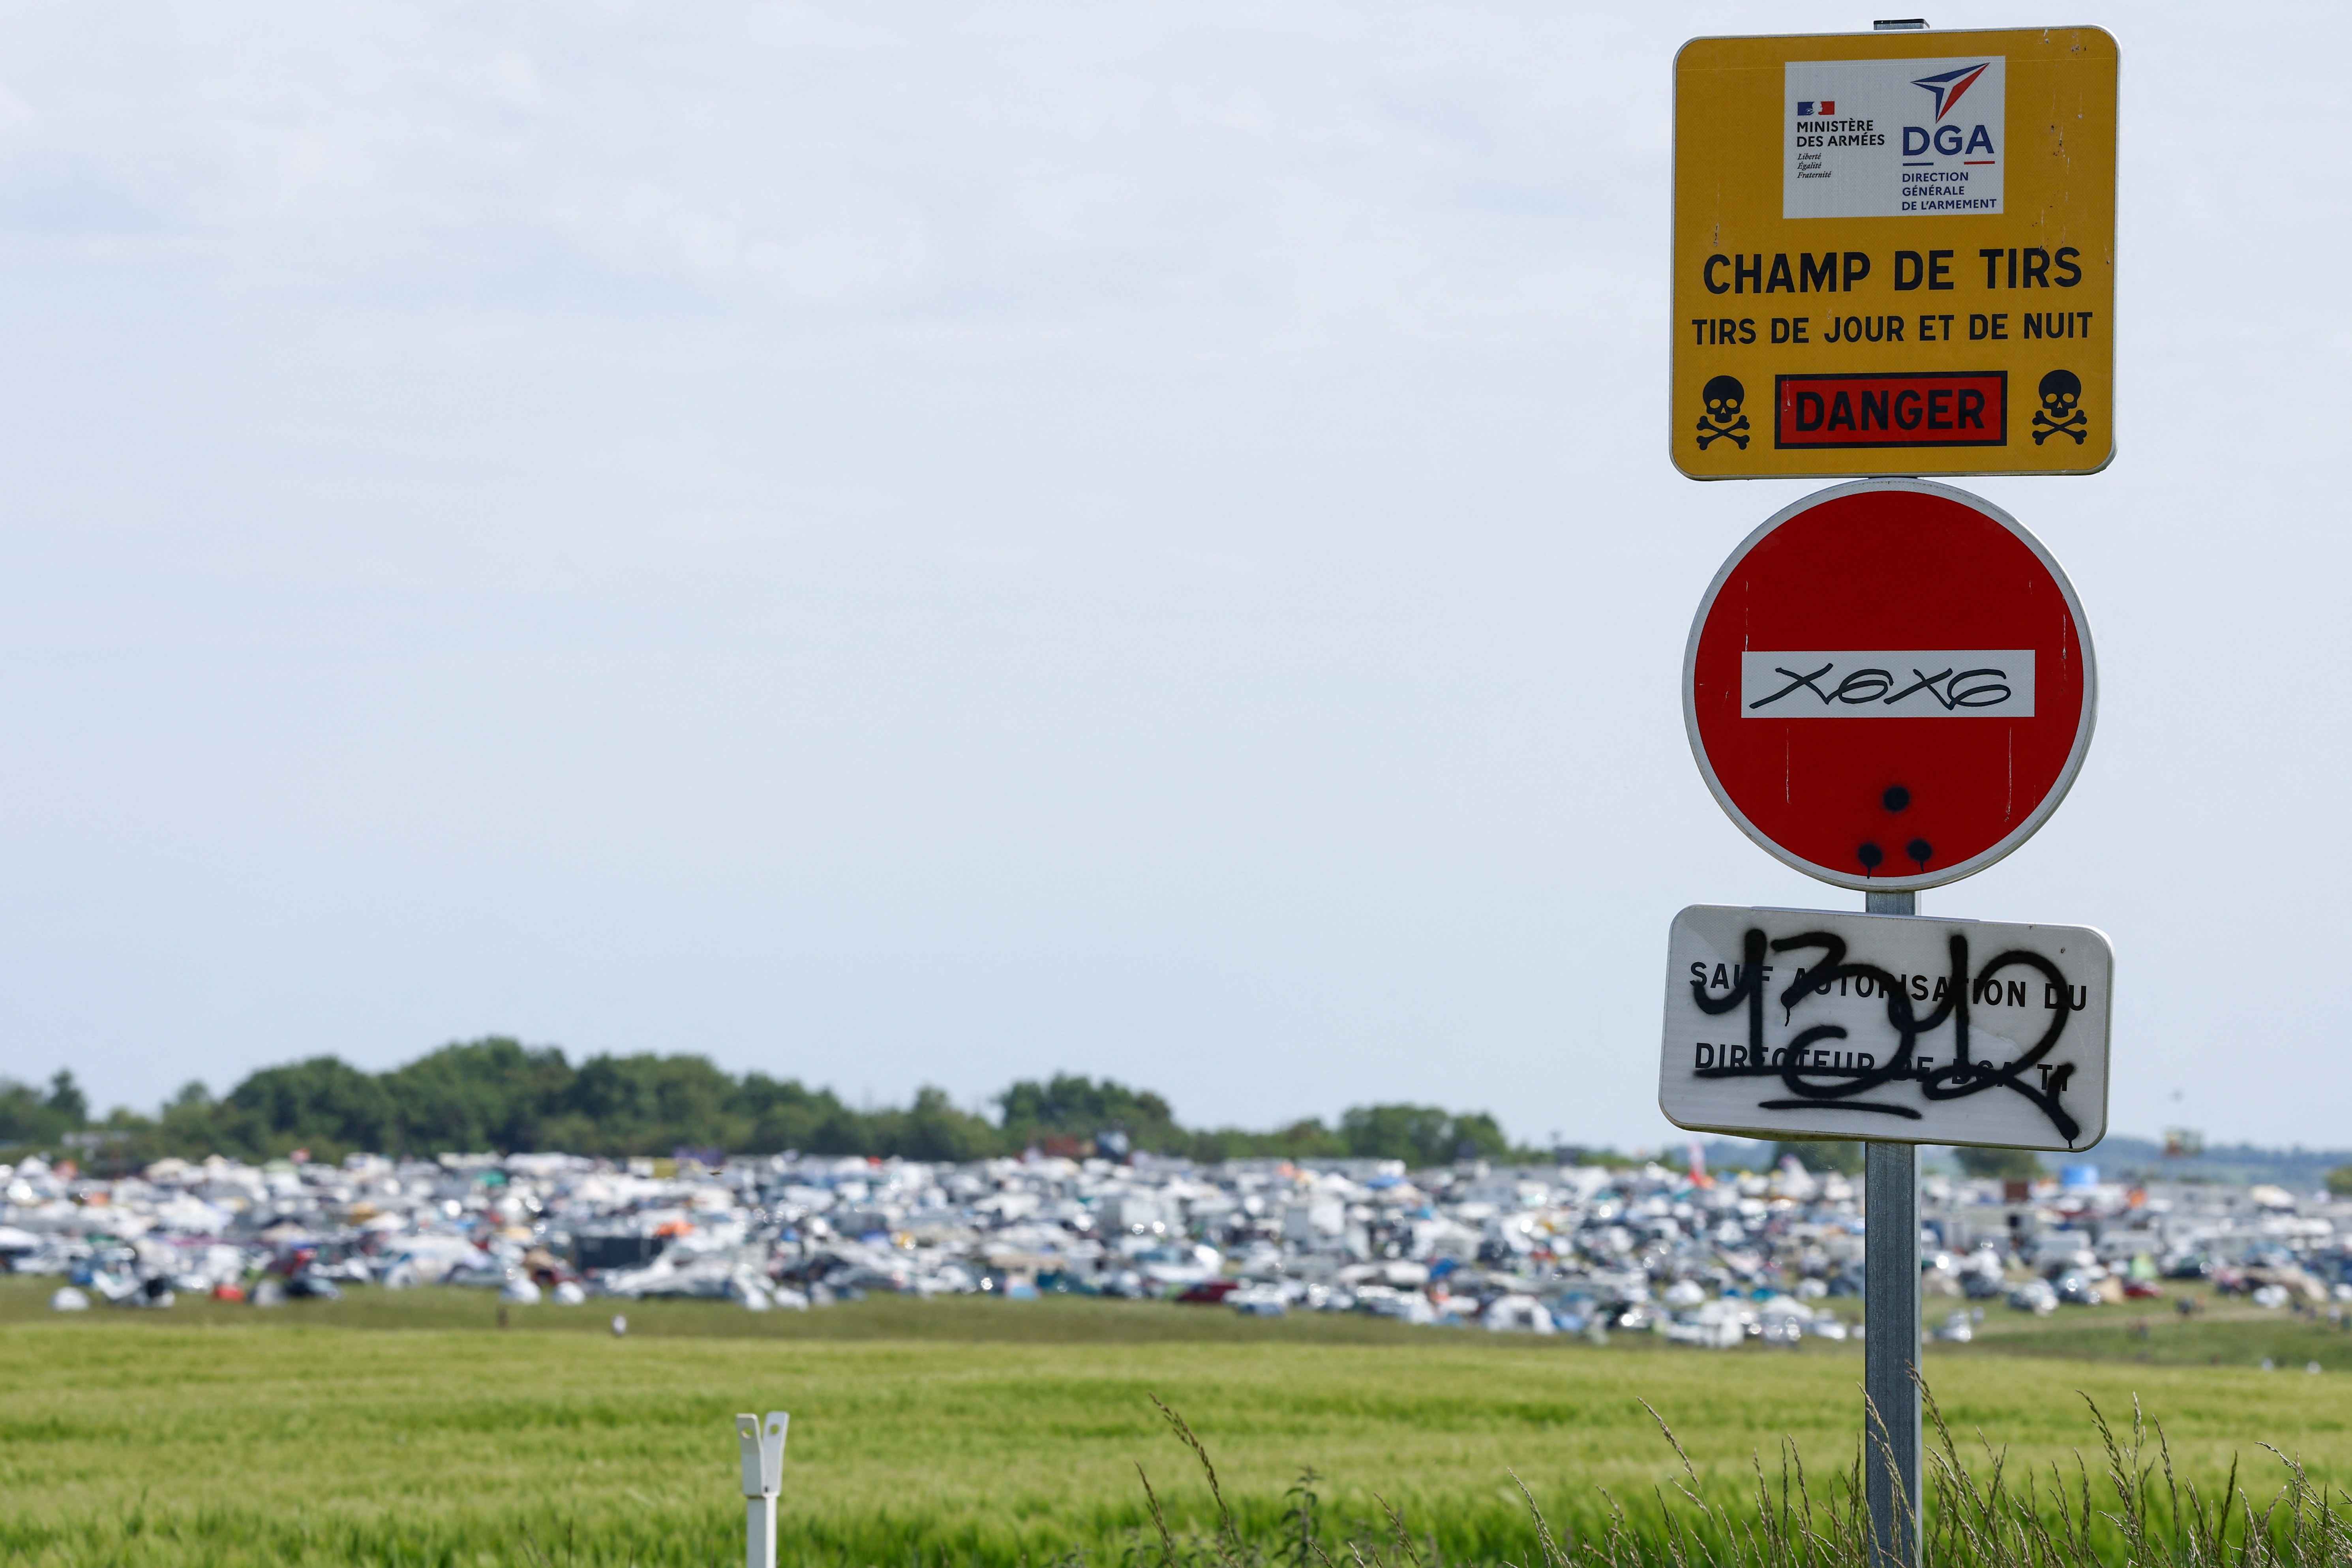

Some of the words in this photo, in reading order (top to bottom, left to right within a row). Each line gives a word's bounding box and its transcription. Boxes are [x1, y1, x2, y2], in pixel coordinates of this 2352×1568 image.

[1797, 118, 1874, 133] MINISTÈRE
[1797, 135, 1823, 147] DES
[1827, 131, 1885, 146] ARMÉES
[1903, 125, 1994, 156] DGA
[1797, 161, 1822, 170] Égalité
[1797, 170, 1832, 178] Fraternité
[1902, 172, 1969, 182] DIRECTION
[1902, 185, 1965, 196] GÉNÉRALE
[1902, 201, 1917, 211] DE
[1703, 251, 1870, 294] CHAMP
[1894, 249, 1954, 291] DE
[1979, 246, 2082, 289] TIRS
[1692, 318, 1756, 345] TIRS
[1771, 317, 1809, 343] DE
[1824, 315, 1904, 343] JOUR
[1919, 315, 1954, 341] ET
[1969, 313, 2008, 340] DE
[2024, 312, 2093, 339] NUIT
[1796, 388, 1985, 431] DANGER
[2045, 983, 2087, 1011] DU
